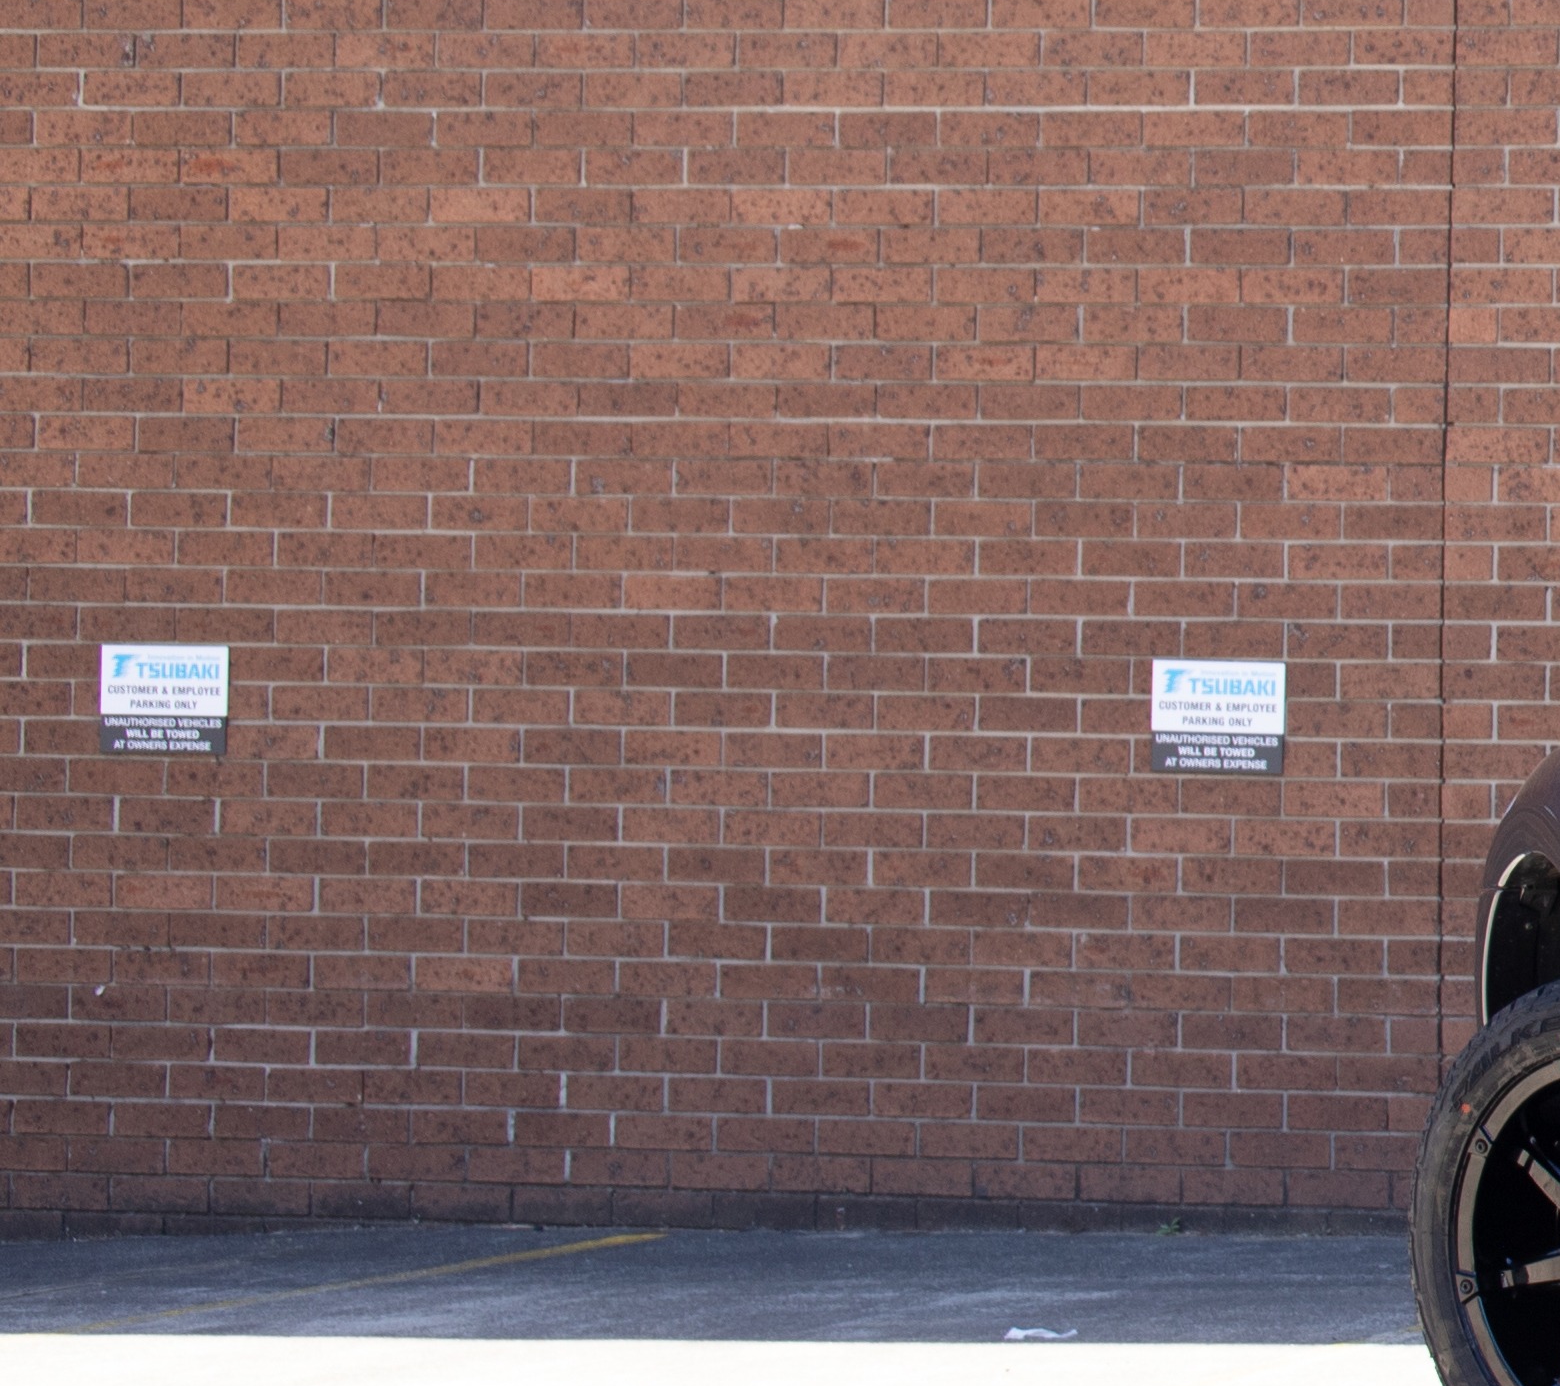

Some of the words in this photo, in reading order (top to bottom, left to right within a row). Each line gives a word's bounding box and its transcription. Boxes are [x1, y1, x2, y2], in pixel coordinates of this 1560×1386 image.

[135, 662, 220, 680] TSUBAKI
[107, 685, 158, 695] CUSTOMER
[161, 686, 169, 695] &
[172, 686, 221, 696] EMPLOYEE
[1188, 678, 1276, 696] TSUBAKI
[130, 700, 171, 709] PARKING
[174, 700, 198, 710] ONLY
[1159, 700, 1211, 710] CUSTOMER
[1215, 702, 1222, 711] &
[1226, 703, 1277, 713] EMPLOYEE
[104, 717, 176, 727] UNAUTHORISED
[177, 717, 222, 728] VEHICLES
[1182, 716, 1224, 726] PARKING
[1228, 717, 1253, 727] ONLY
[125, 728, 149, 738] WILL
[150, 729, 164, 739] BE
[165, 729, 200, 739] TOWED
[113, 740, 125, 749] AT
[126, 740, 167, 750] OWNERS
[168, 741, 212, 751] EXPENSE
[1155, 734, 1230, 745] UNAUTHORISED
[1232, 735, 1278, 747] VEHICLES
[1177, 746, 1201, 756] WILL
[1203, 747, 1217, 756] BE
[1219, 747, 1255, 757] TOWED
[1165, 757, 1177, 767] AT
[1179, 758, 1221, 769] OWNERS
[1223, 759, 1267, 770] EXPENSE
